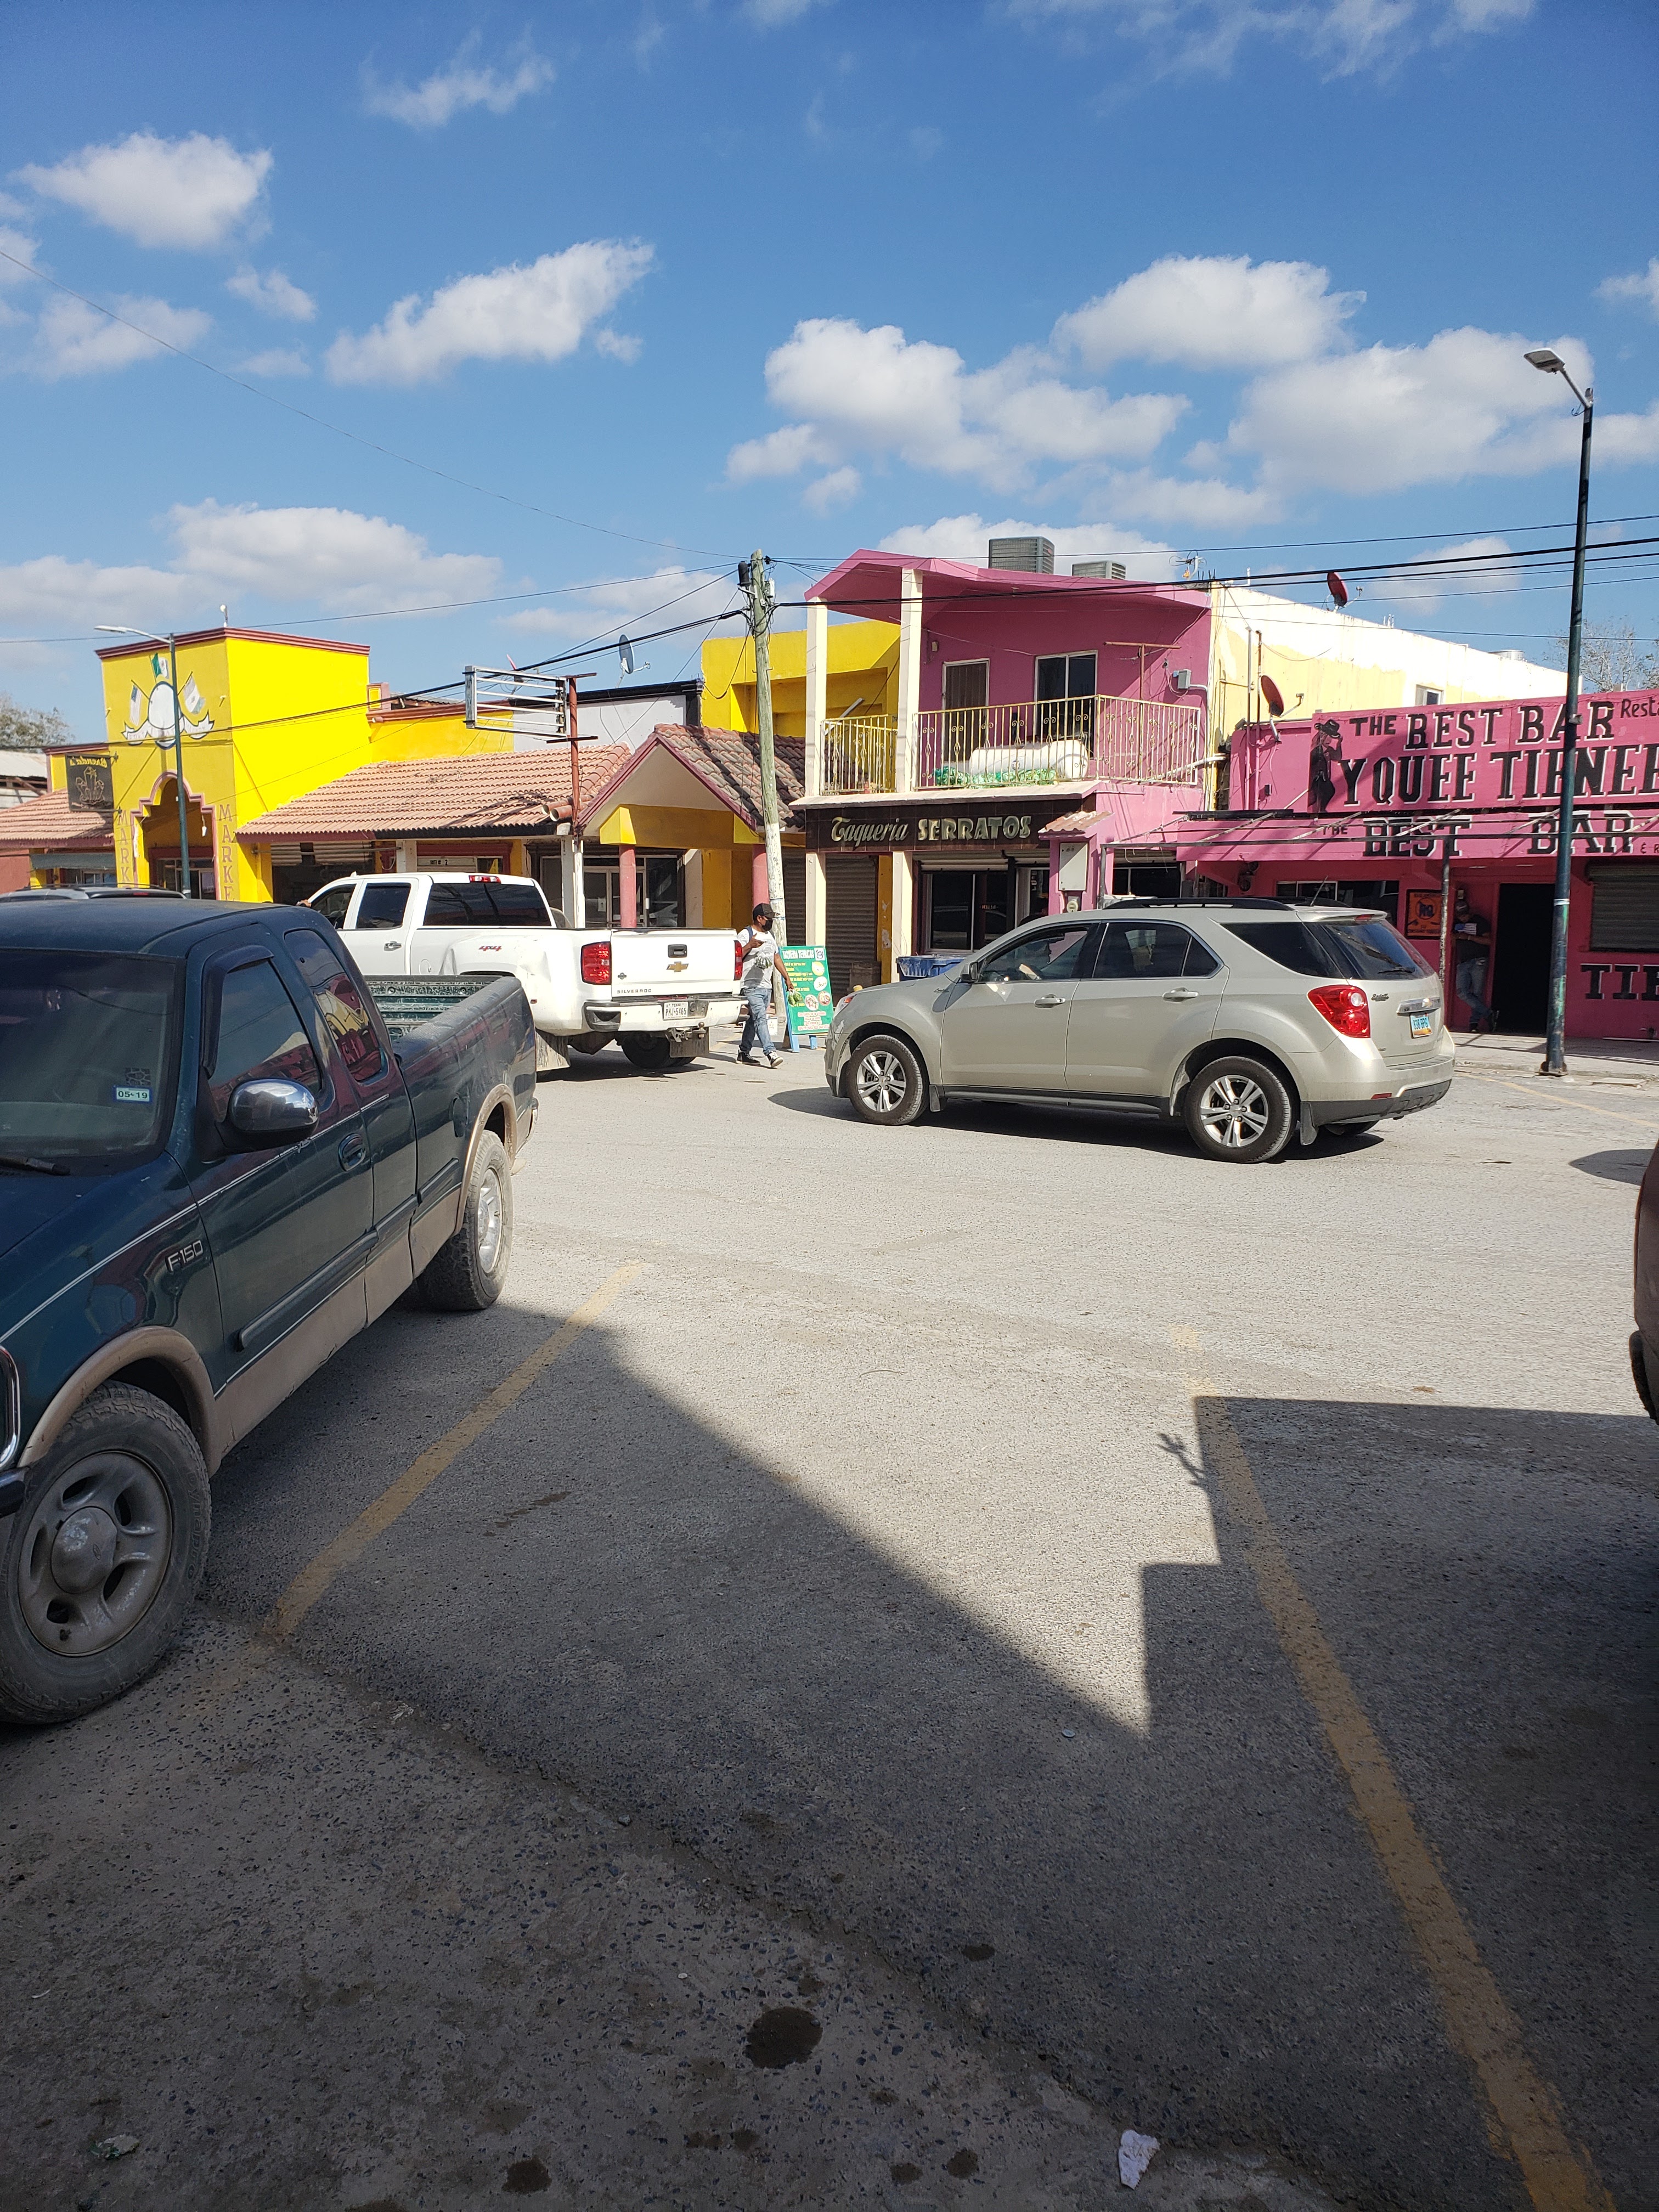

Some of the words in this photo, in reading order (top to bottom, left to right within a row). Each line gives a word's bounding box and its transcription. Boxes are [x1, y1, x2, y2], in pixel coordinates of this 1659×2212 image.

[1349, 715, 1397, 736] THE
[1403, 708, 1503, 751] BEST
[1515, 701, 1615, 745] BAR
[1620, 697, 1659, 718] Rest
[831, 817, 909, 847] Taqueria
[917, 815, 1031, 841] SERRATOS
[1362, 815, 1472, 857] BEST
[1527, 810, 1634, 855] BAR
